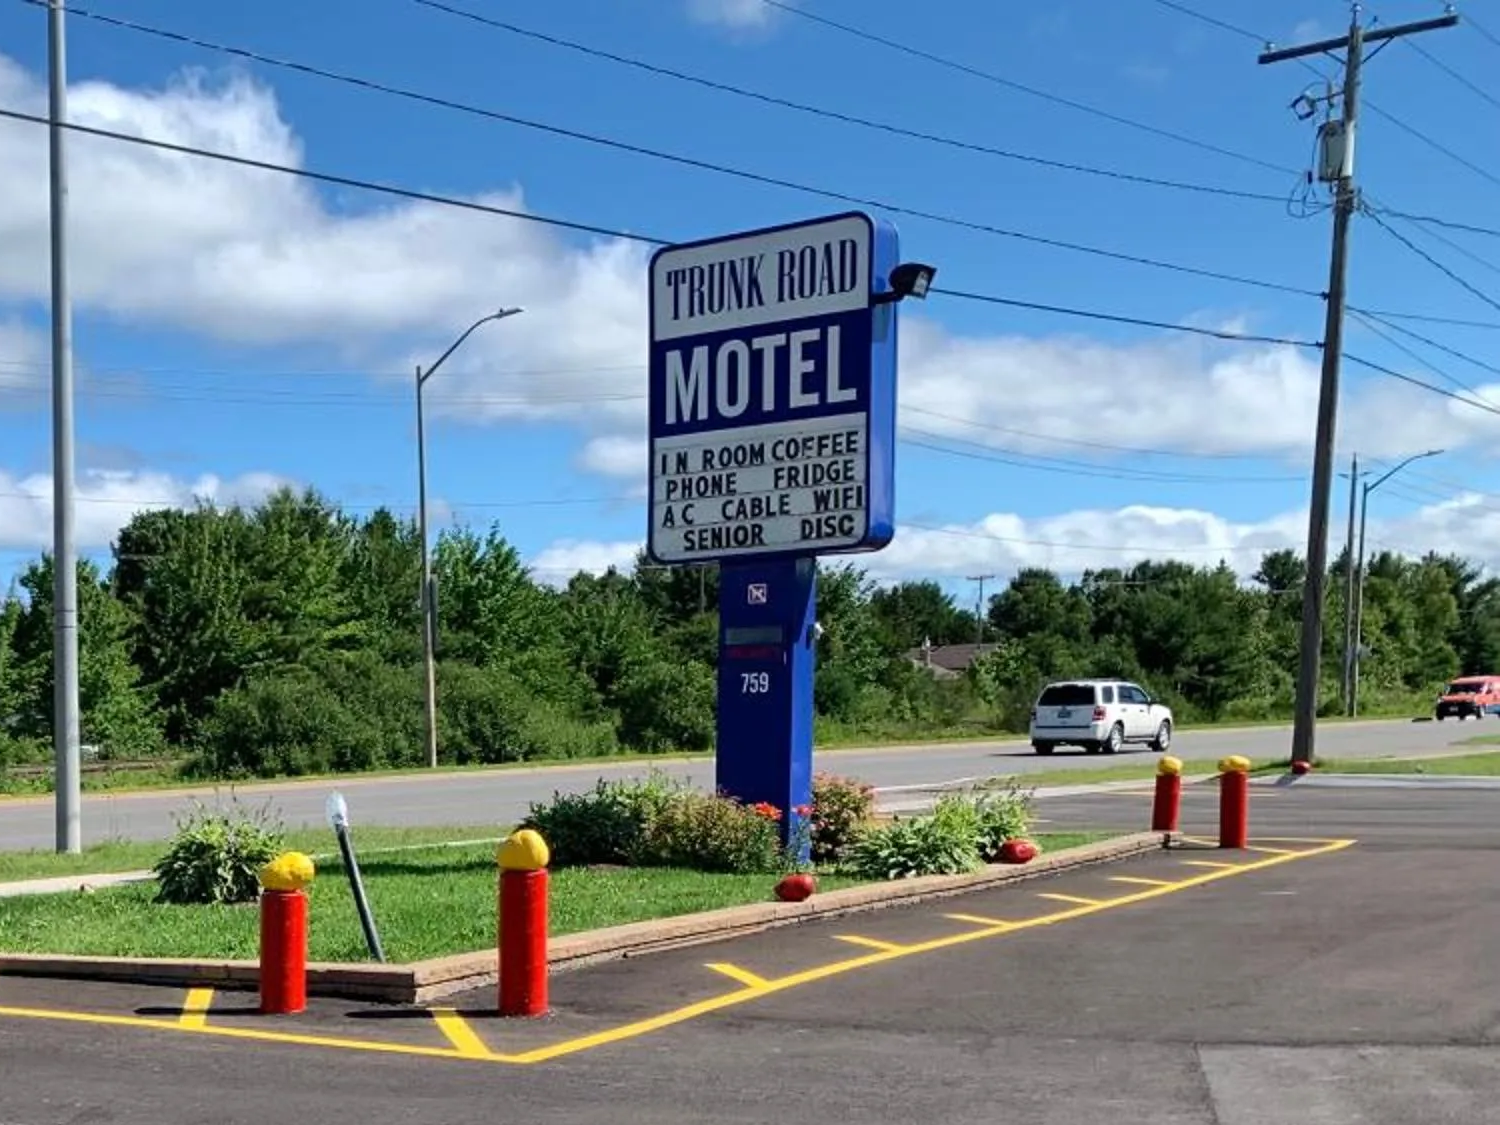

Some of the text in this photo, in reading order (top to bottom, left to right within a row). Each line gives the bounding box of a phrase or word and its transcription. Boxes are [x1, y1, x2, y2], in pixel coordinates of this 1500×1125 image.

[666, 239, 857, 320] TRUNK ROAD
[665, 325, 857, 424] MOTEL
[661, 431, 858, 475] IN ROOM COFFEE
[666, 459, 855, 499] PHONE FRIDGE
[721, 493, 790, 521] CABLE
[813, 485, 862, 512] WIFI
[683, 514, 854, 551] SENIOR DISC
[740, 672, 770, 694] 759
